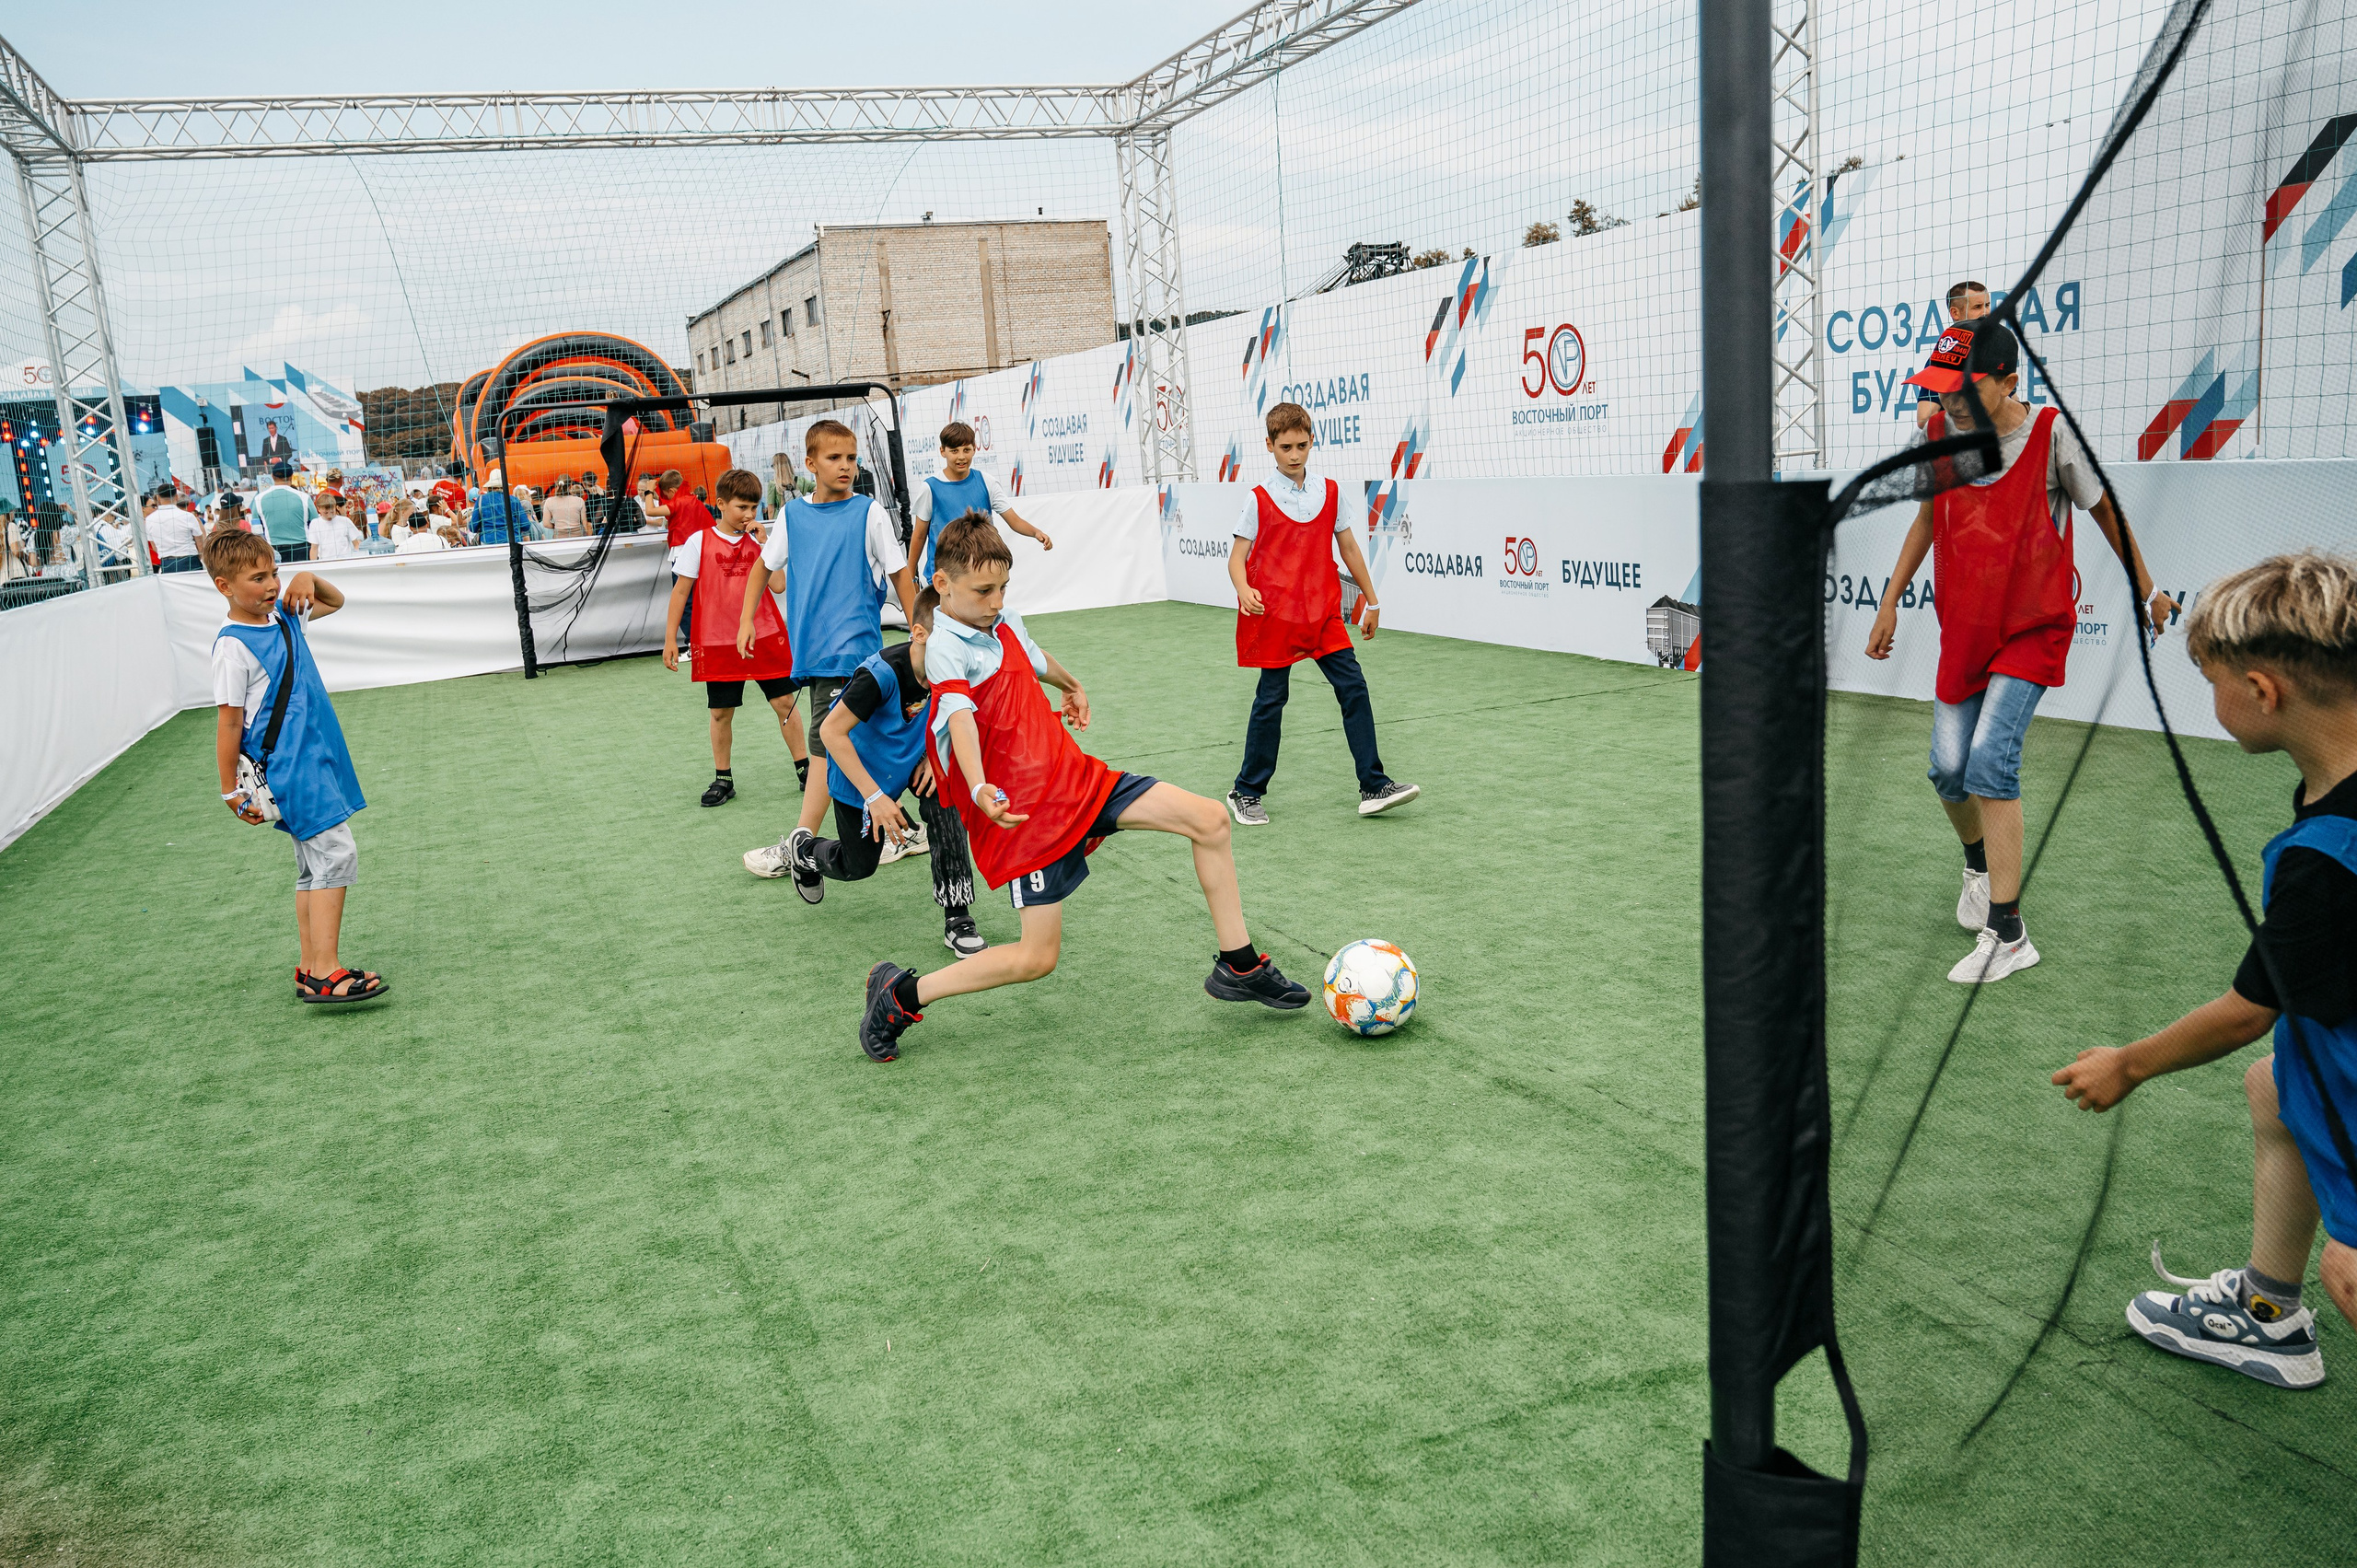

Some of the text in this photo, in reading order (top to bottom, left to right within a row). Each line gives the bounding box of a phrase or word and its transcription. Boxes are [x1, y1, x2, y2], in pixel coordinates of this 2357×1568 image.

[1827, 282, 2081, 354] СОЗДАЯ
[1522, 323, 1585, 399] 50
[1282, 373, 1370, 412] СОЗДАВАЯ
[1582, 381, 1596, 394] ЛЕТ
[1852, 357, 2048, 420] БУДЕ
[1042, 413, 1088, 437] СОЗДАВАЯ
[1513, 403, 1608, 424] ВОСТОЧНЫЙ ПОРТ
[1311, 415, 1361, 450] ДУЩЕЕ
[1515, 425, 1608, 437] АКЦИОНЕРНОЕ ОБЩЕСТВО
[908, 436, 935, 454] СОЗДАВАЯ
[1049, 443, 1085, 466] БУДУЩЕЕ
[1179, 538, 1229, 559] СОЗДАВАЯ
[1504, 537, 1538, 576] 50
[1405, 552, 1483, 578] СОЗДАВАЯ
[1562, 560, 1642, 591] БУДУЩЕЕ
[1500, 579, 1549, 591] ВОСТОЧНЫЙ ПОРТ
[2078, 604, 2094, 614] ЛЕТ
[1029, 869, 1046, 892] 9
